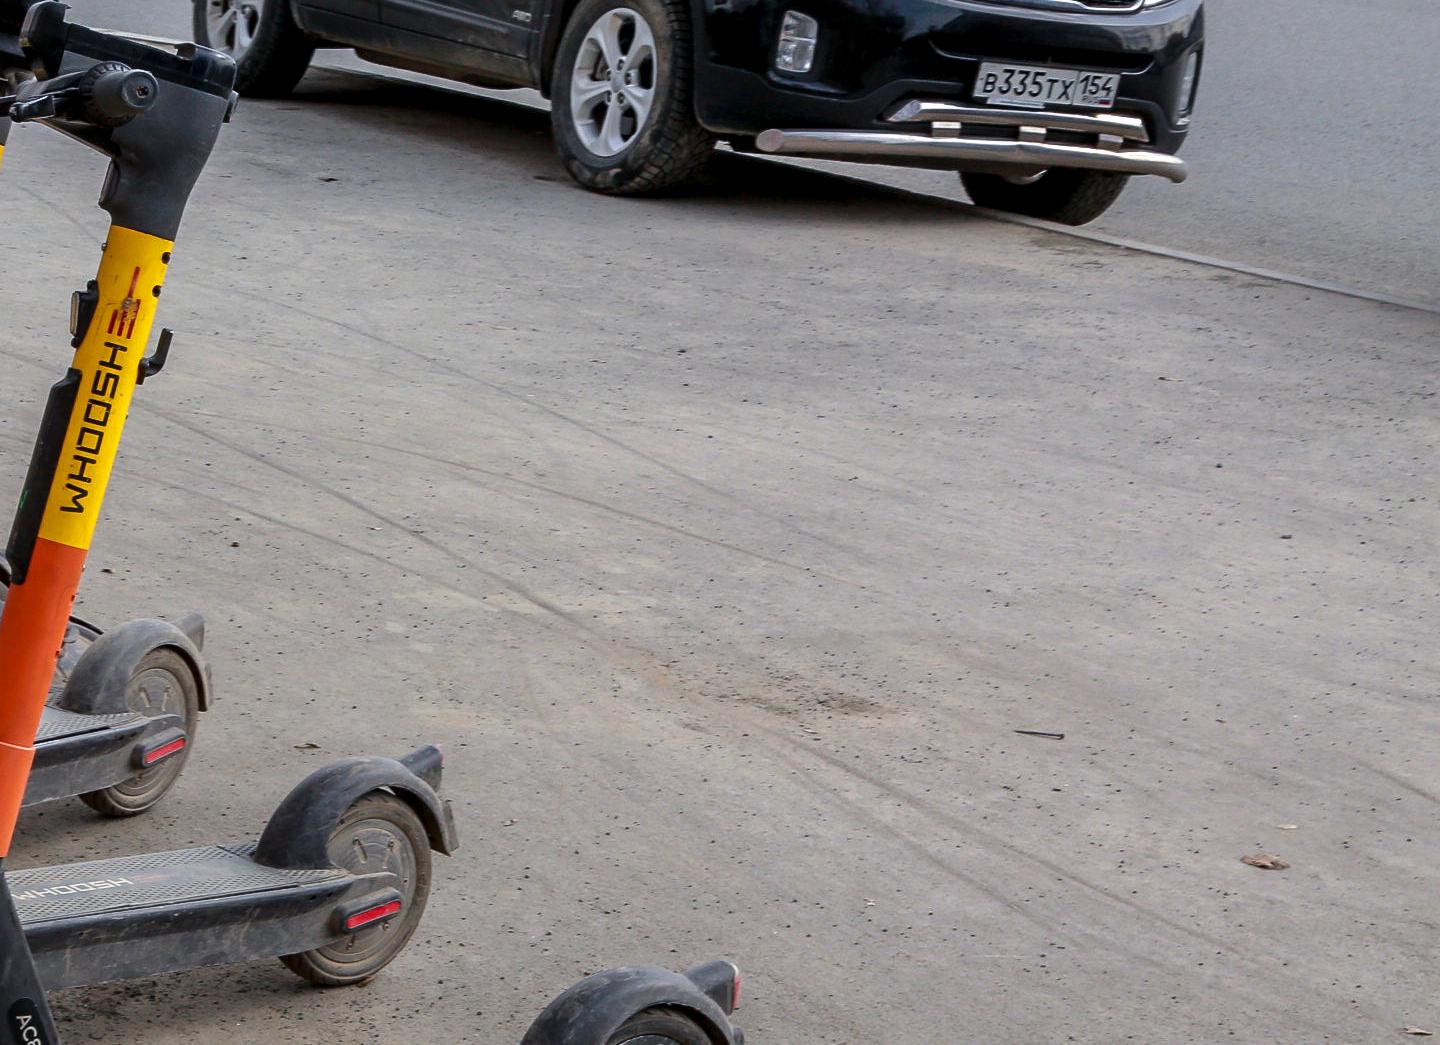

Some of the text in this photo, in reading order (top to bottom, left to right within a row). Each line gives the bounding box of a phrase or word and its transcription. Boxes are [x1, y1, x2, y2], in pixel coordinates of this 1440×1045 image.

[982, 68, 1113, 100] В335ТХ 154
[60, 341, 128, 513] WHOOSH
[11, 878, 134, 900] WHOOSH
